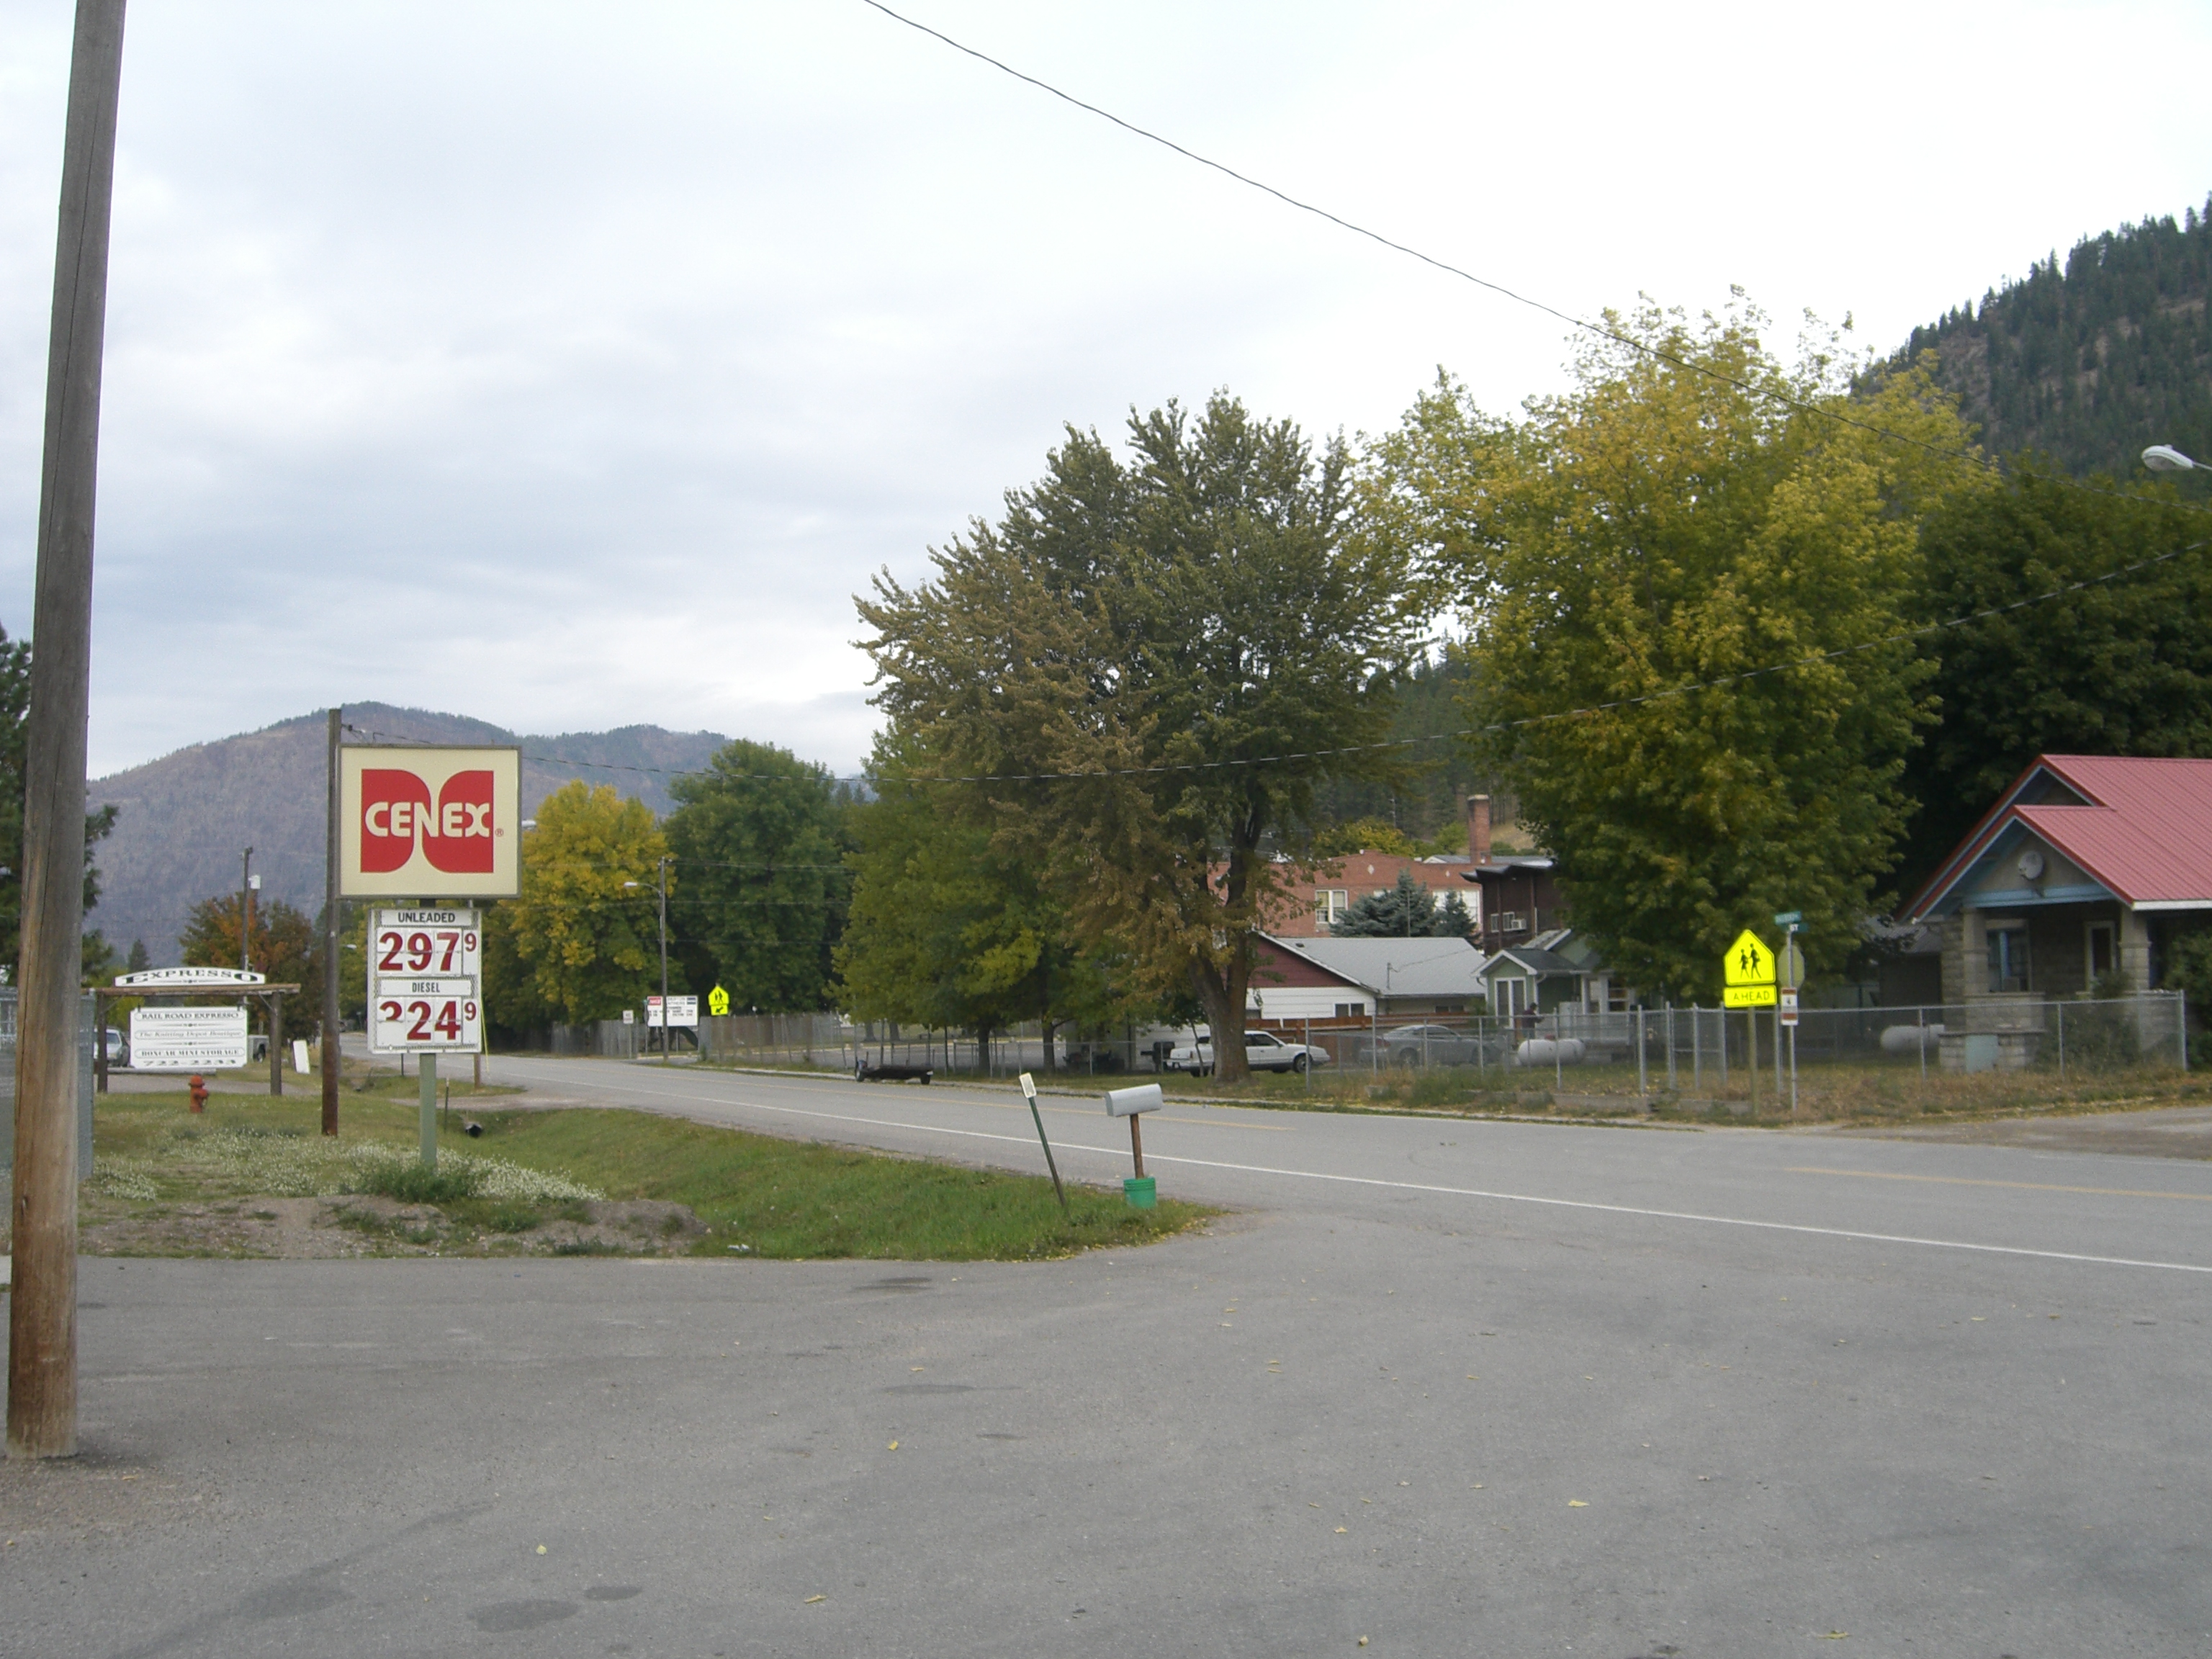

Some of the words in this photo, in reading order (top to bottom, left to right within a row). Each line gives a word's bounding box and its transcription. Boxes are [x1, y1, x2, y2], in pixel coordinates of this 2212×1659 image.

[365, 801, 490, 837] CENEX
[398, 912, 455, 923] UNLEADED
[378, 932, 460, 971] 297
[464, 932, 477, 952] 9
[122, 969, 258, 985] EXPRESSO
[412, 982, 440, 992] DIESEL
[1733, 990, 1770, 1002] AHEAD
[464, 1002, 477, 1021] 9
